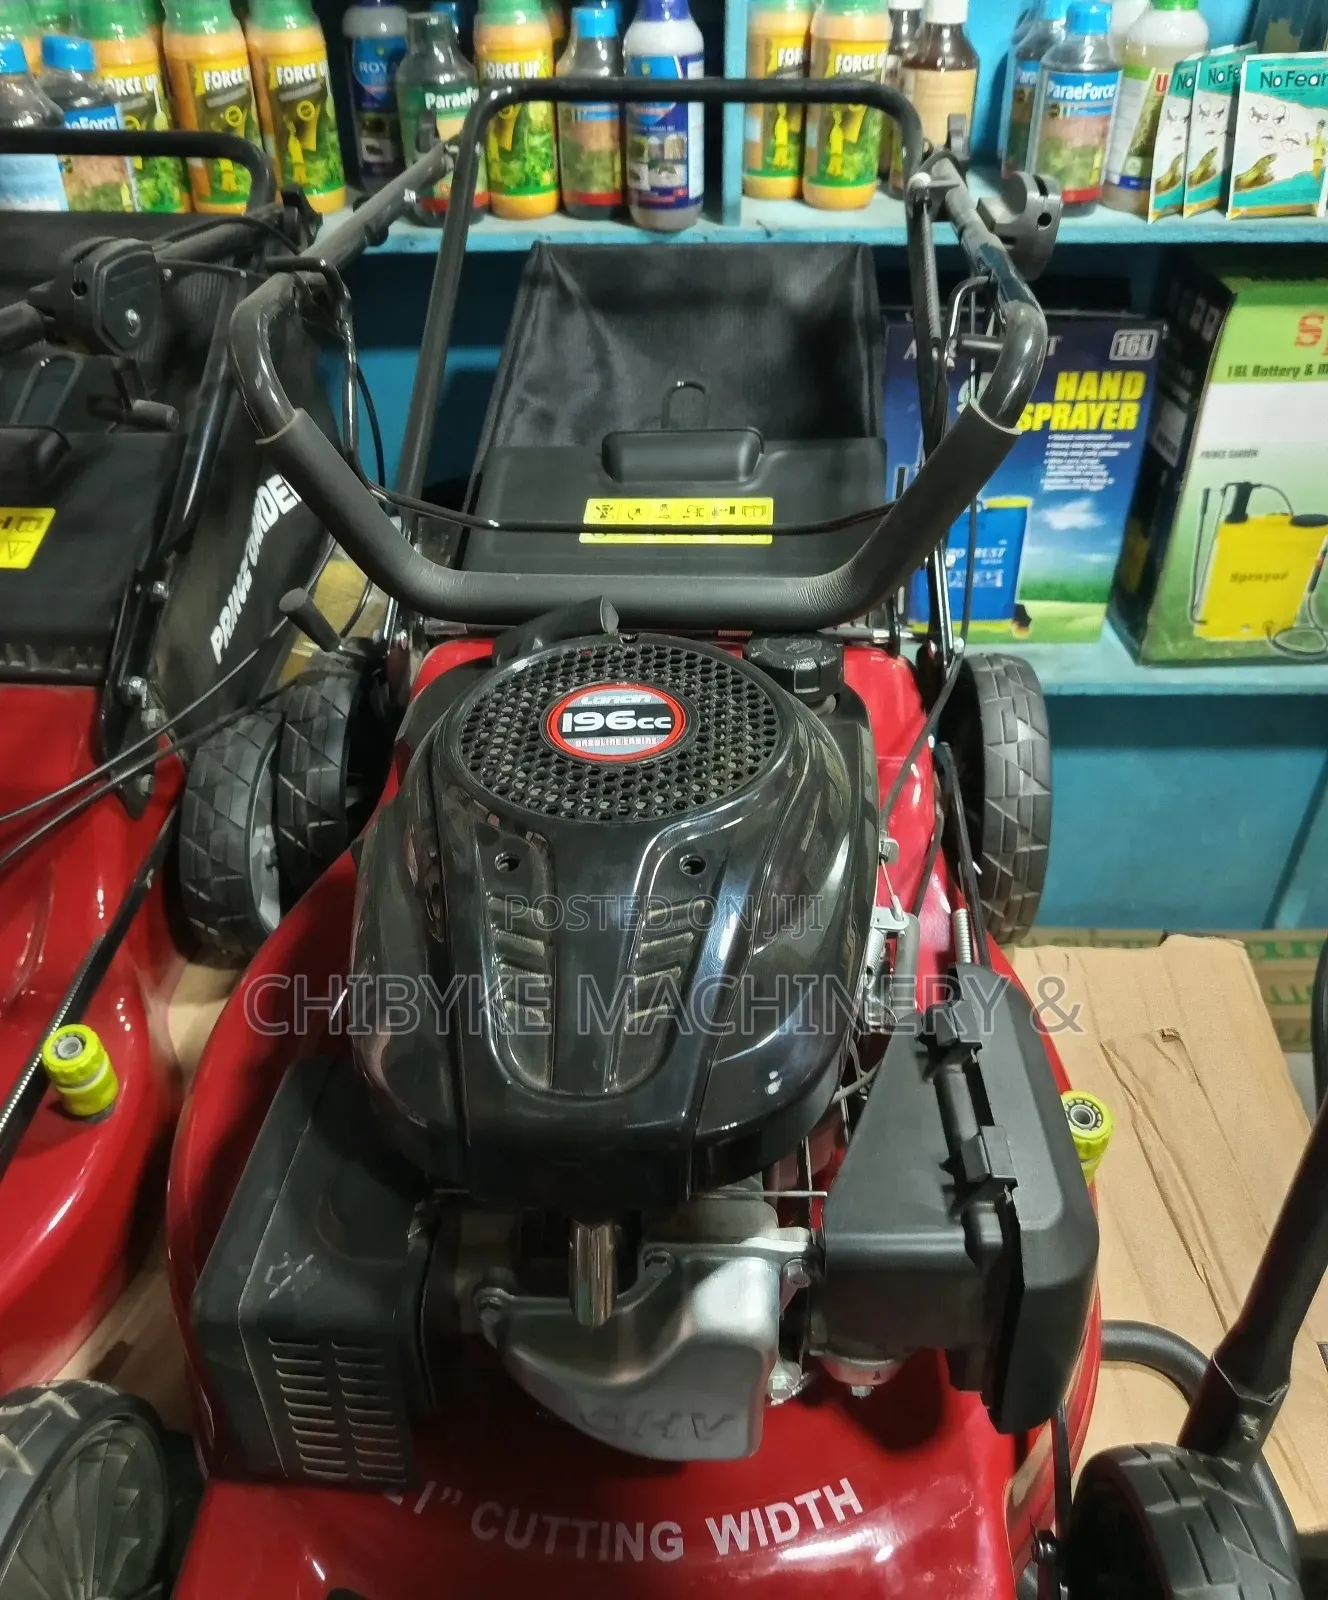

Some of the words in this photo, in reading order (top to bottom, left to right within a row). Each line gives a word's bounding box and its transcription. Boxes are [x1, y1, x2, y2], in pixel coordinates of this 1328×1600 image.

[482, 61, 520, 79] FORCE
[523, 60, 541, 78] UP
[836, 55, 875, 74] FORCE
[203, 67, 242, 91] FORCE
[276, 64, 317, 86] FORCE
[1176, 73, 1194, 91] No
[1208, 68, 1224, 85] No
[1261, 71, 1283, 88] No
[1285, 70, 1328, 87] Fear
[1047, 79, 1116, 101] ParaeForce
[1252, 364, 1300, 380] Battery
[1054, 371, 1147, 400] HAND
[1016, 402, 1141, 431] SPRAYER
[562, 710, 672, 733] 196cc
[575, 737, 622, 748] GASOLINE
[623, 736, 658, 746] ENGINE
[471, 1502, 685, 1562] CUTTING
[706, 1478, 864, 1556] WIDTH
